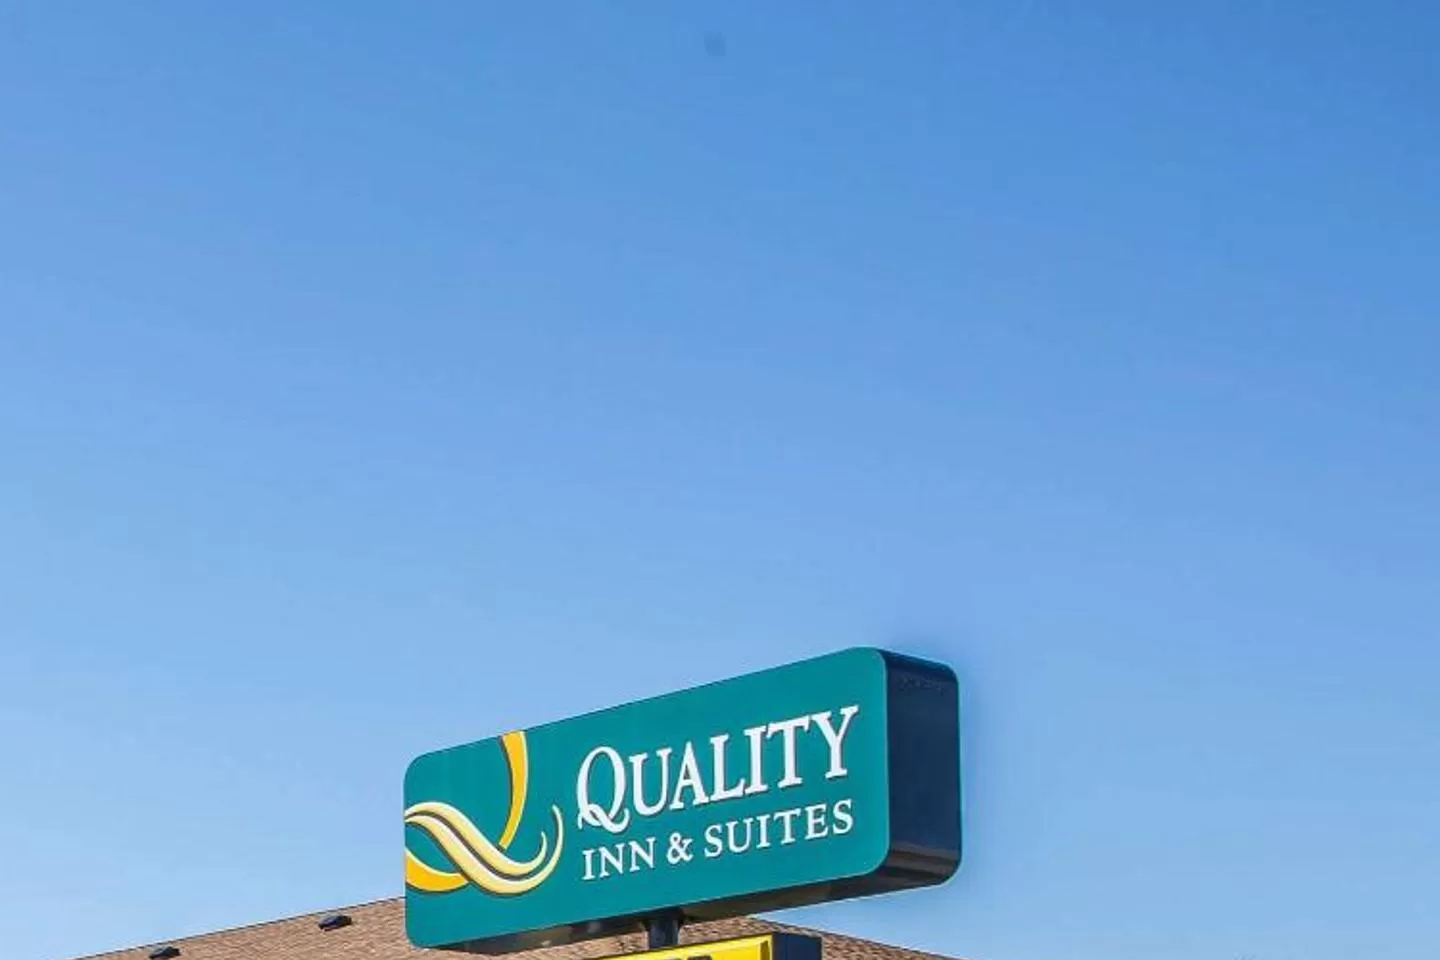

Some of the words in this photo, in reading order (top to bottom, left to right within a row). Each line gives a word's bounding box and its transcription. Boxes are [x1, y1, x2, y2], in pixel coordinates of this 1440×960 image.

[576, 705, 859, 834] QUALITY
[582, 837, 656, 880] INN
[666, 832, 693, 864] &
[704, 799, 854, 858] SUITES
